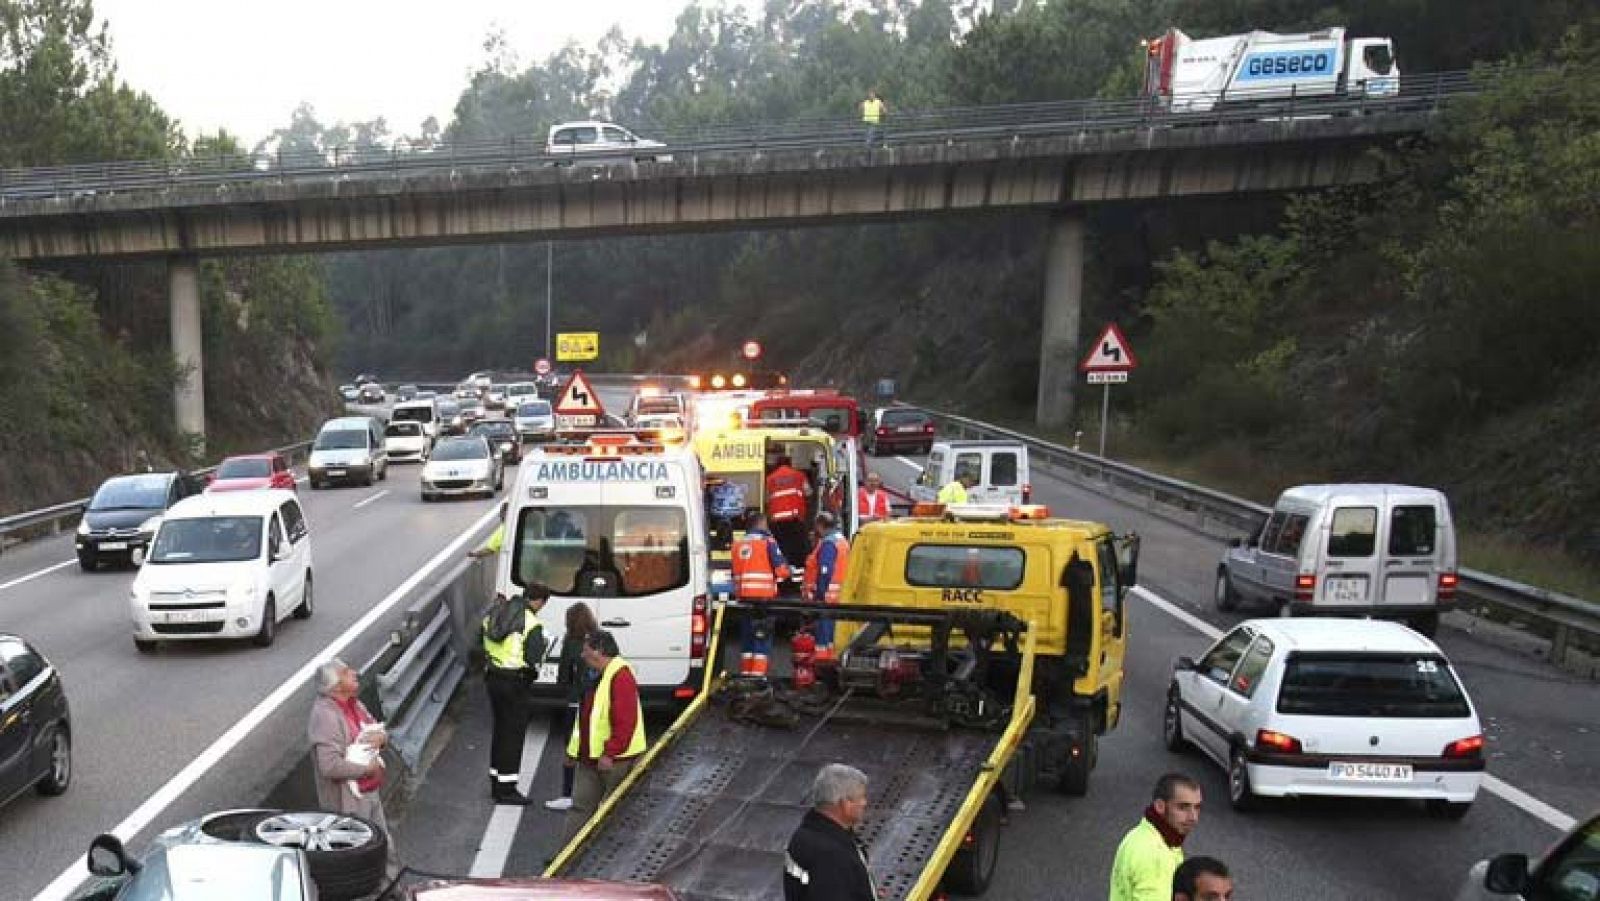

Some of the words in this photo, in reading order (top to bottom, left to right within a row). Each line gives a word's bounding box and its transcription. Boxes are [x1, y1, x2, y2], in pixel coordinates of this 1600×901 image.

[711, 442, 765, 460] AMBUL
[537, 462, 669, 481] AMBULANCIA
[941, 588, 983, 603] RACC
